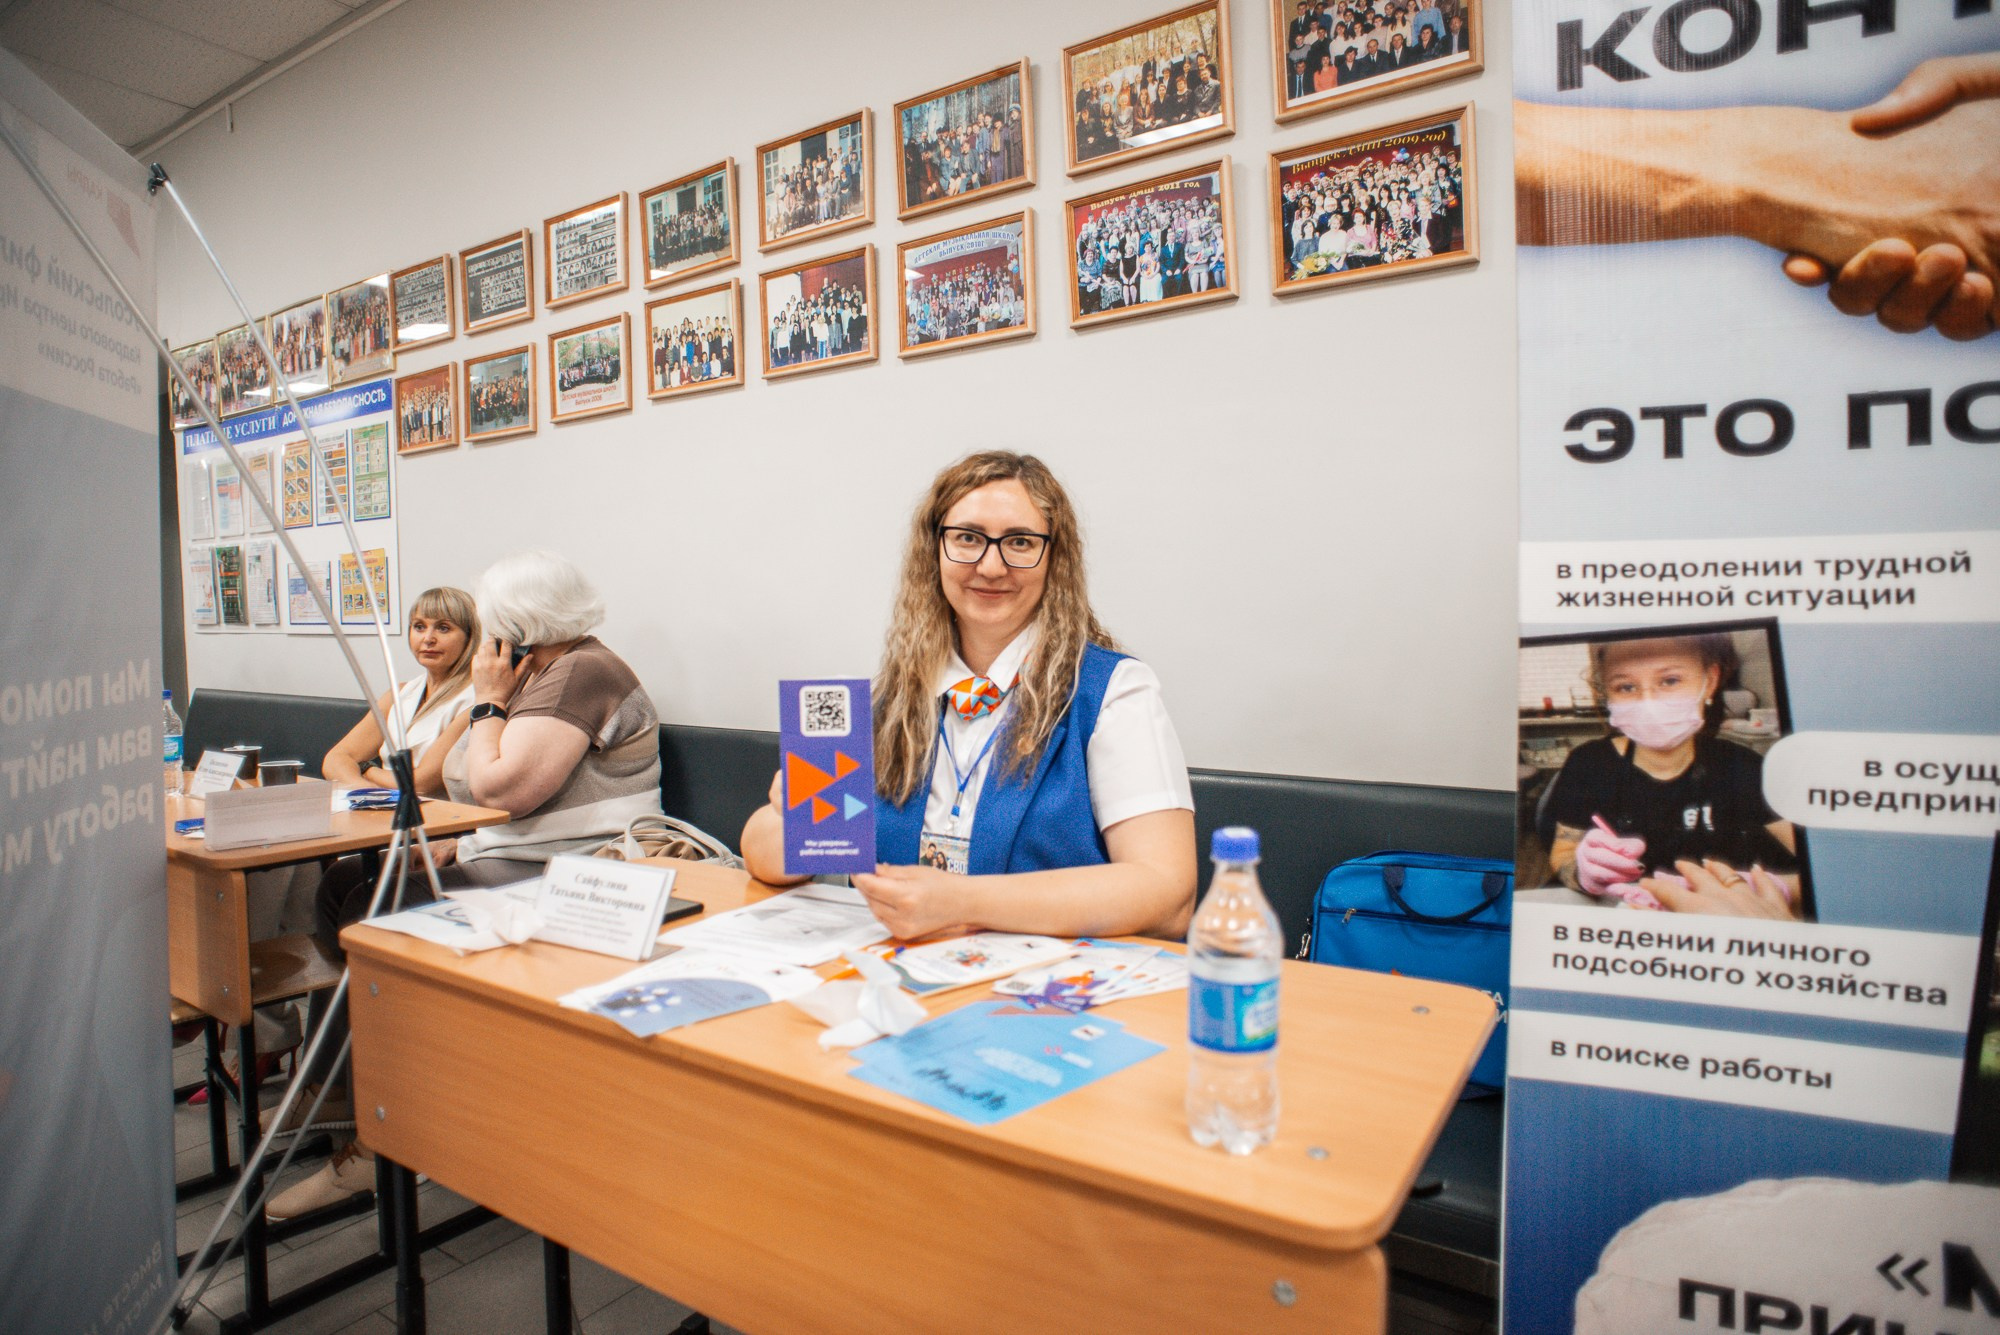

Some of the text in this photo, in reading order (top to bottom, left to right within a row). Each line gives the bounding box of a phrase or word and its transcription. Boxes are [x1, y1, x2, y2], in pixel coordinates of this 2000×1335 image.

[1557, 0, 1991, 91] КОН
[1385, 136, 1419, 147] 2009
[1090, 195, 1126, 211] Выпуск
[1158, 181, 1180, 191] 2011
[939, 244, 964, 257] ВЫПУСК
[991, 231, 1015, 242] ШКОЛА
[234, 416, 276, 437] УСЛУГИ
[1563, 398, 1796, 464] ЭТО
[1556, 551, 1972, 583] в преодолении трудной
[1556, 584, 1916, 611] жизненной ситуации
[1864, 761, 2000, 787] в осущ
[1553, 925, 1870, 967] в ведении личного
[1552, 953, 1948, 1007] подсобного хозяйства
[1551, 1040, 1832, 1090] в поиске работы
[1679, 1279, 1957, 1335] ПРИ
